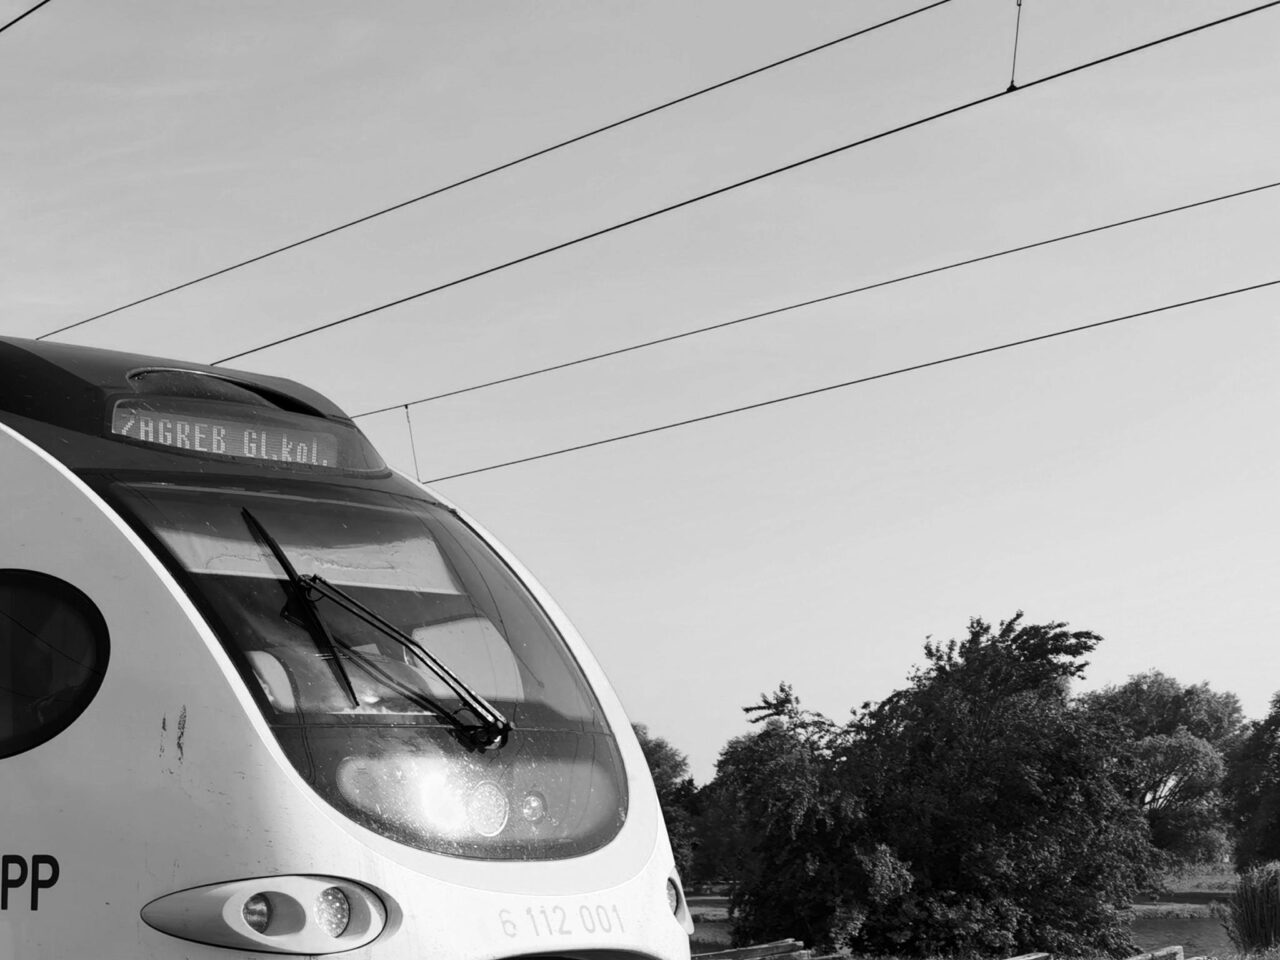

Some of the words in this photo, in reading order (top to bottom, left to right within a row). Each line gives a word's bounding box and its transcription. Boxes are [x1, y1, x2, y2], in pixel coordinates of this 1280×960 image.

[498, 908, 517, 938] 6
[526, 905, 572, 936] 112
[579, 904, 625, 934] 001
